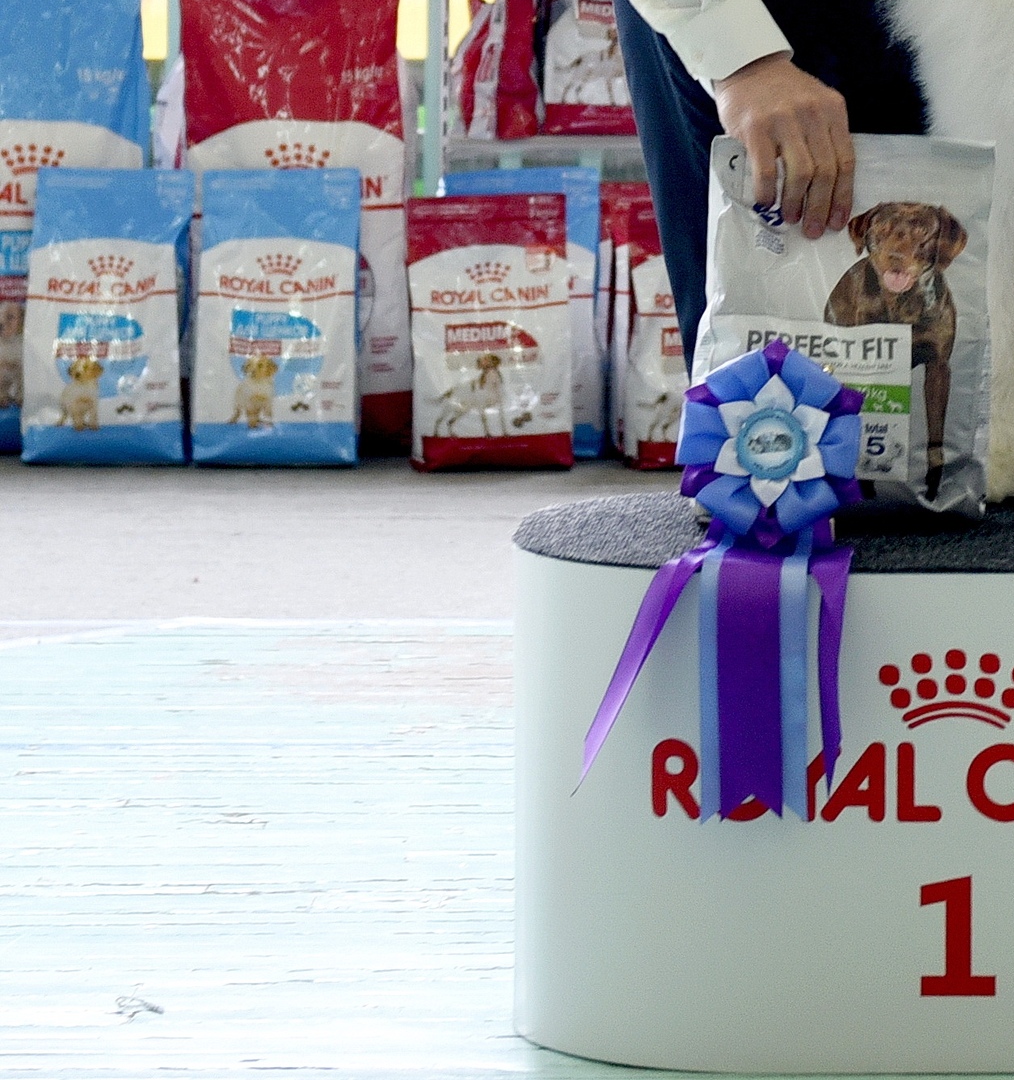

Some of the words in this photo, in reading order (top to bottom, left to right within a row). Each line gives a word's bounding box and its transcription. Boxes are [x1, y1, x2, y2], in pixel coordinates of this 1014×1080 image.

[580, 2, 612, 17] MED
[220, 275, 274, 295] ROYAL
[280, 275, 336, 295] CANIN
[430, 289, 486, 305] ROYAL
[491, 284, 549, 303] CANIN
[449, 325, 509, 342] MEDIUM
[862, 336, 899, 360] FIT
[865, 436, 886, 456] 5
[652, 738, 942, 822] RAL
[920, 875, 996, 997] 1
